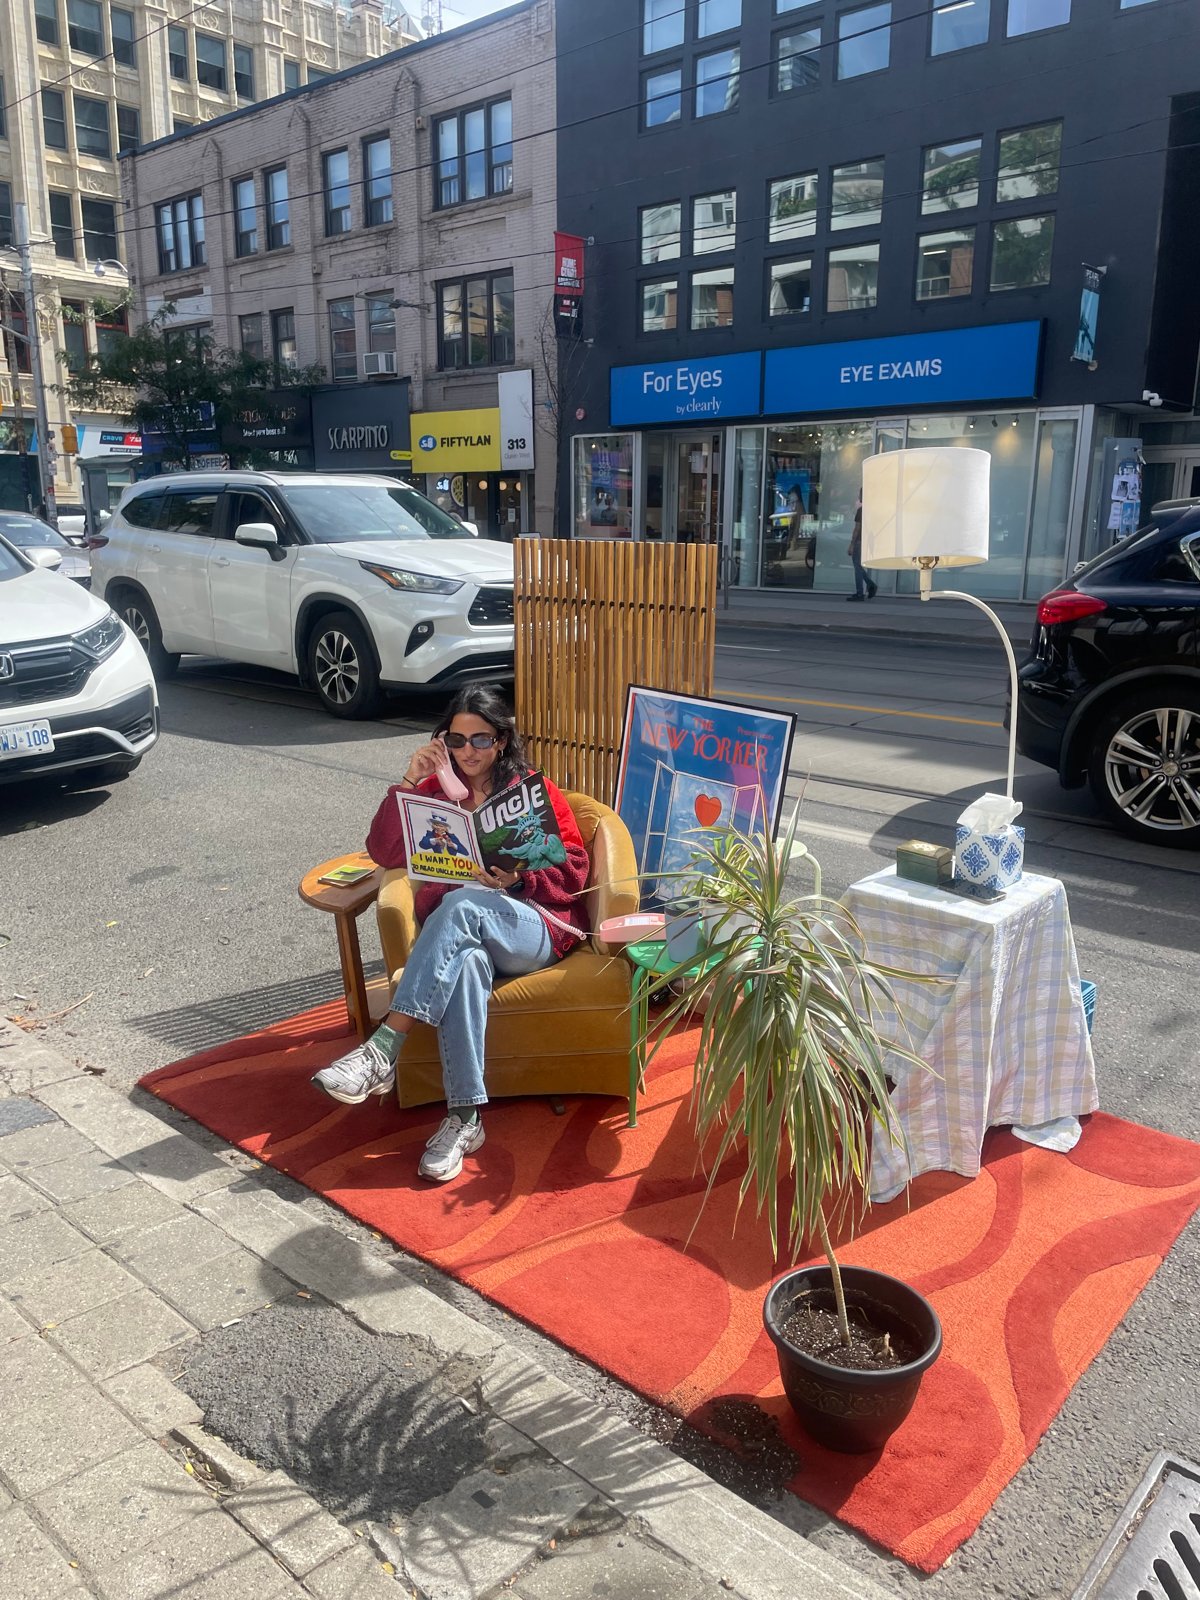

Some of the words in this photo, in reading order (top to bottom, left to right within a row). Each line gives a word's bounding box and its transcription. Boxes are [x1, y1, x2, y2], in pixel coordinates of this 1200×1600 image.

[840, 365, 874, 383] EYE
[878, 359, 942, 380] EXAMS
[643, 371, 673, 394] For
[676, 367, 723, 395] Eyes
[676, 405, 686, 415] by
[686, 396, 722, 415] clearly
[328, 424, 388, 450] SCARPINO
[440, 434, 491, 448] FIFTYLAN
[507, 437, 527, 450] 313
[692, 717, 715, 732] THE
[0, 733, 18, 751] WJ
[26, 729, 49, 748] 108
[640, 720, 689, 751] NEW
[691, 730, 769, 773] YORKER
[425, 855, 450, 866] WANT
[451, 857, 473, 871] YOU
[435, 868, 455, 877] UNCLE
